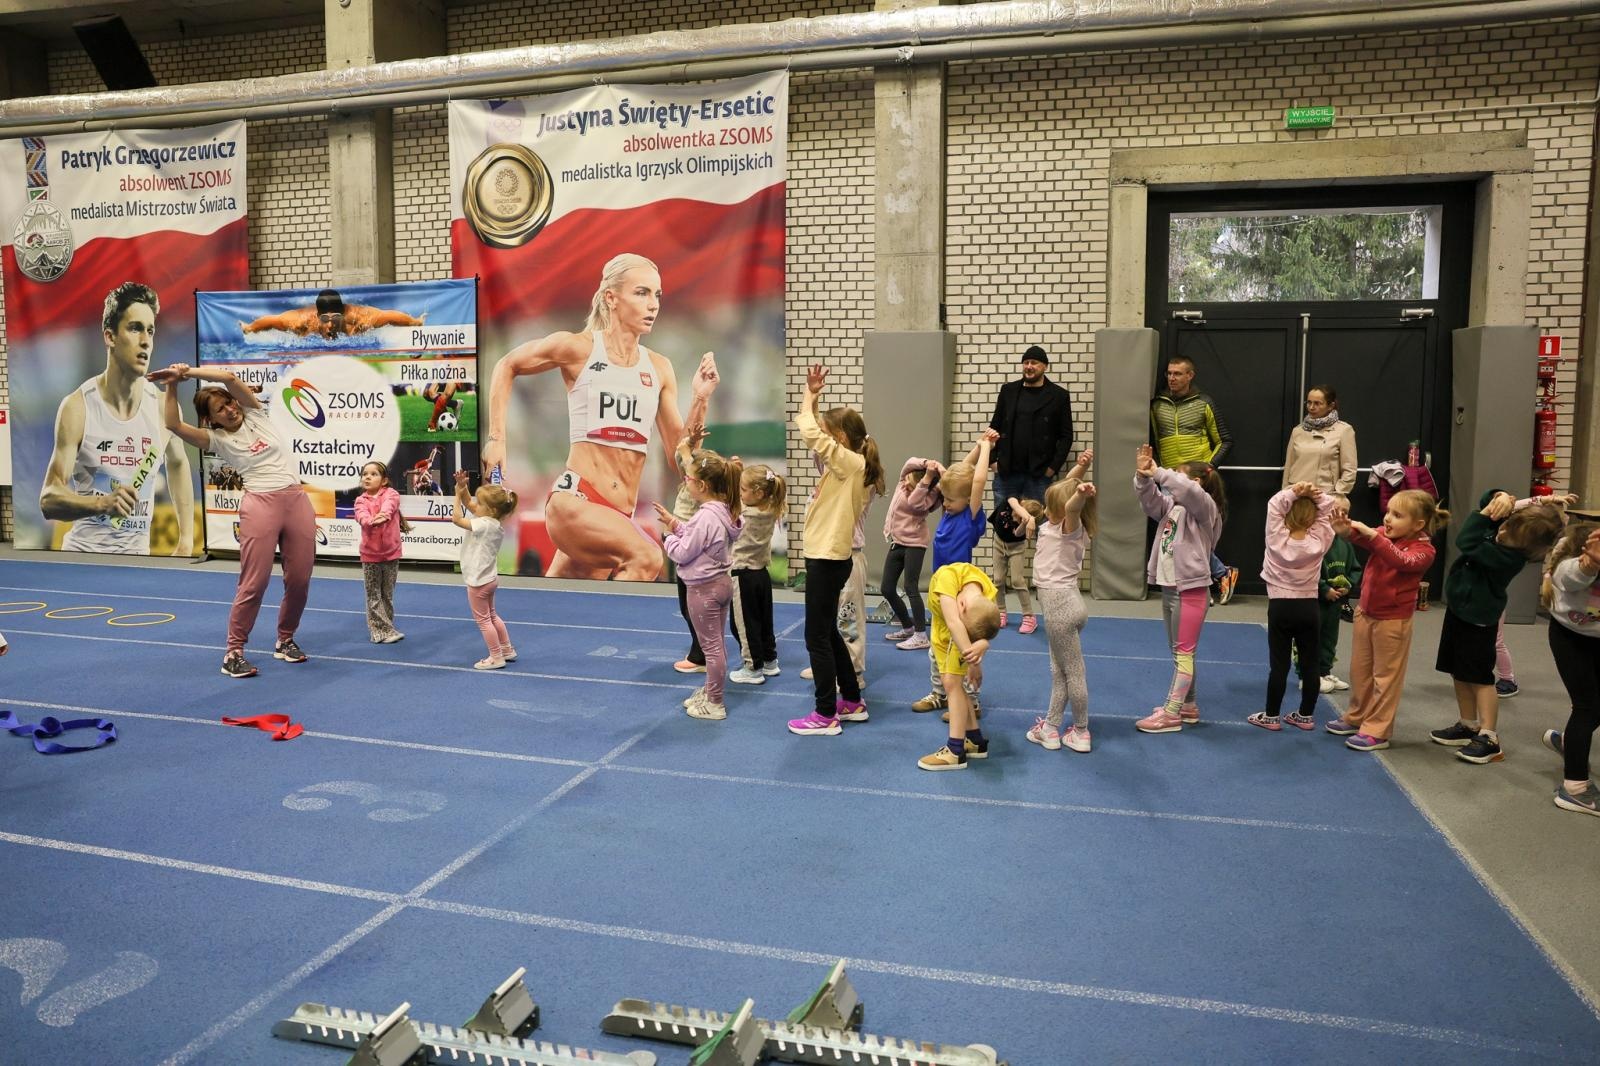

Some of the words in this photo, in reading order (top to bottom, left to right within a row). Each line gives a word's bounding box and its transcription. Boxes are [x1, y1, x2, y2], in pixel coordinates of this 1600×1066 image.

[537, 107, 613, 138] Justyna
[619, 90, 775, 130] Święty-Ersetic
[623, 129, 715, 153] absolwentka
[719, 126, 773, 146] ZSOMS
[61, 145, 112, 172] Patryk
[115, 137, 236, 170] Grzegorzewicz
[561, 162, 632, 183] medalistka
[636, 157, 683, 181] Igrzysk
[687, 153, 773, 177] Olimpijskich
[119, 172, 188, 192] absolwent
[190, 168, 232, 190] ZSOMS
[71, 201, 124, 220] medalista
[126, 200, 197, 217] Mistrzostw
[199, 194, 237, 214] Świata
[412, 329, 466, 350] Pływanie
[224, 368, 277, 387] atletyka
[401, 364, 428, 380] Piłka
[432, 364, 467, 380] nożna
[328, 392, 385, 409] ZSOMS
[599, 391, 642, 423] POL
[328, 411, 385, 419] RACIBÓRZ
[96, 441, 113, 452] 4F
[293, 439, 375, 459] Kształcimy
[100, 456, 143, 467] POLSK
[133, 469, 149, 491] SIA
[558, 473, 573, 489] 3
[214, 494, 240, 512] Klasy
[428, 500, 467, 519] Zapay
[401, 535, 463, 546] smsraciborz.pl
[282, 779, 449, 823] 3
